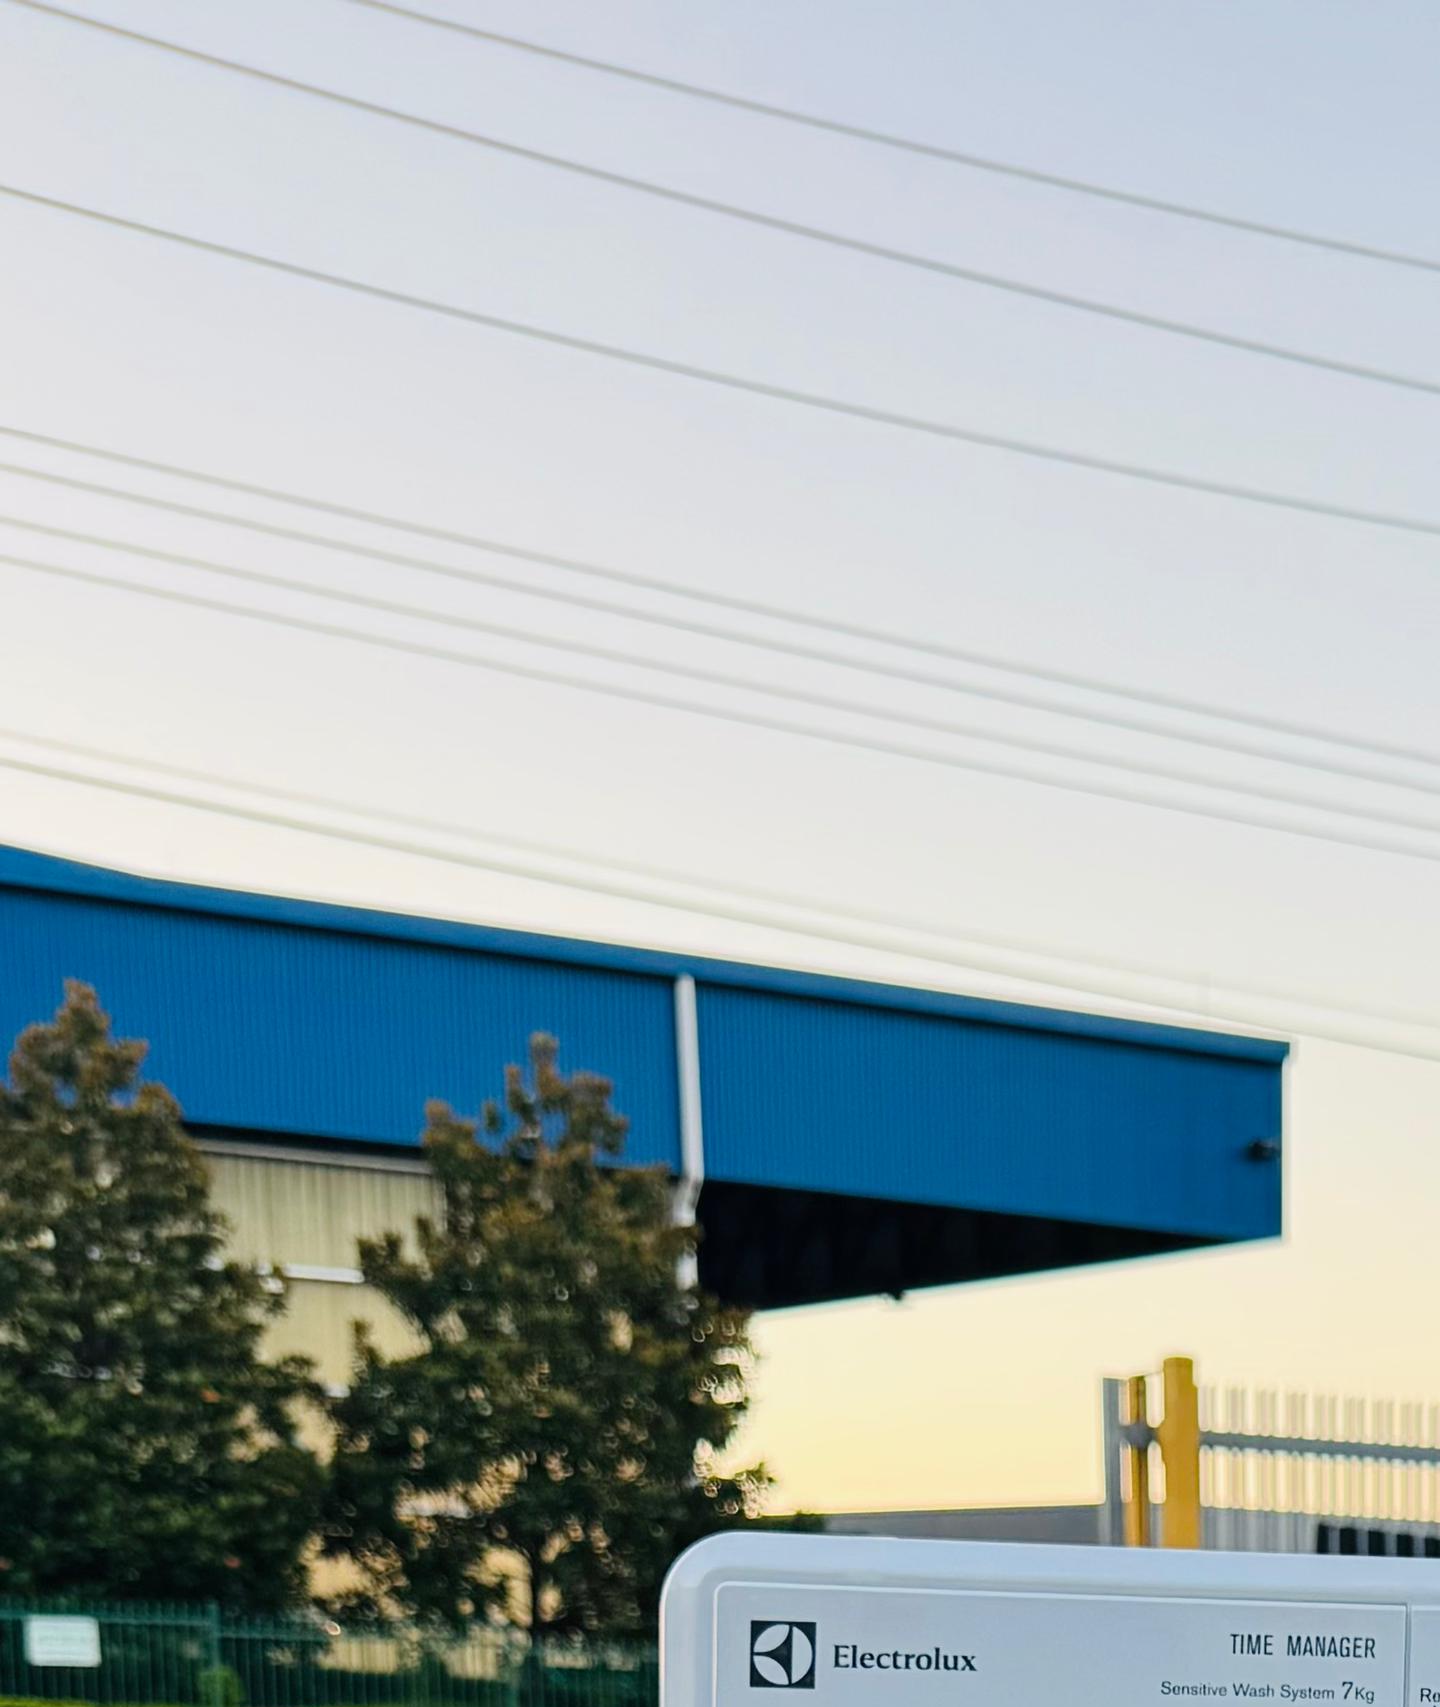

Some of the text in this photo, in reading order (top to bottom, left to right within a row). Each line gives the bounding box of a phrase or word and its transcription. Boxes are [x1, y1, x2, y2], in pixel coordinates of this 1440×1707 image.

[832, 1644, 978, 1672] Electrolux
[1230, 1633, 1377, 1660] TIME MANAGER
[1160, 1681, 1228, 1699] Sensitive
[1232, 1683, 1276, 1700] Wash
[1280, 1684, 1336, 1703] System
